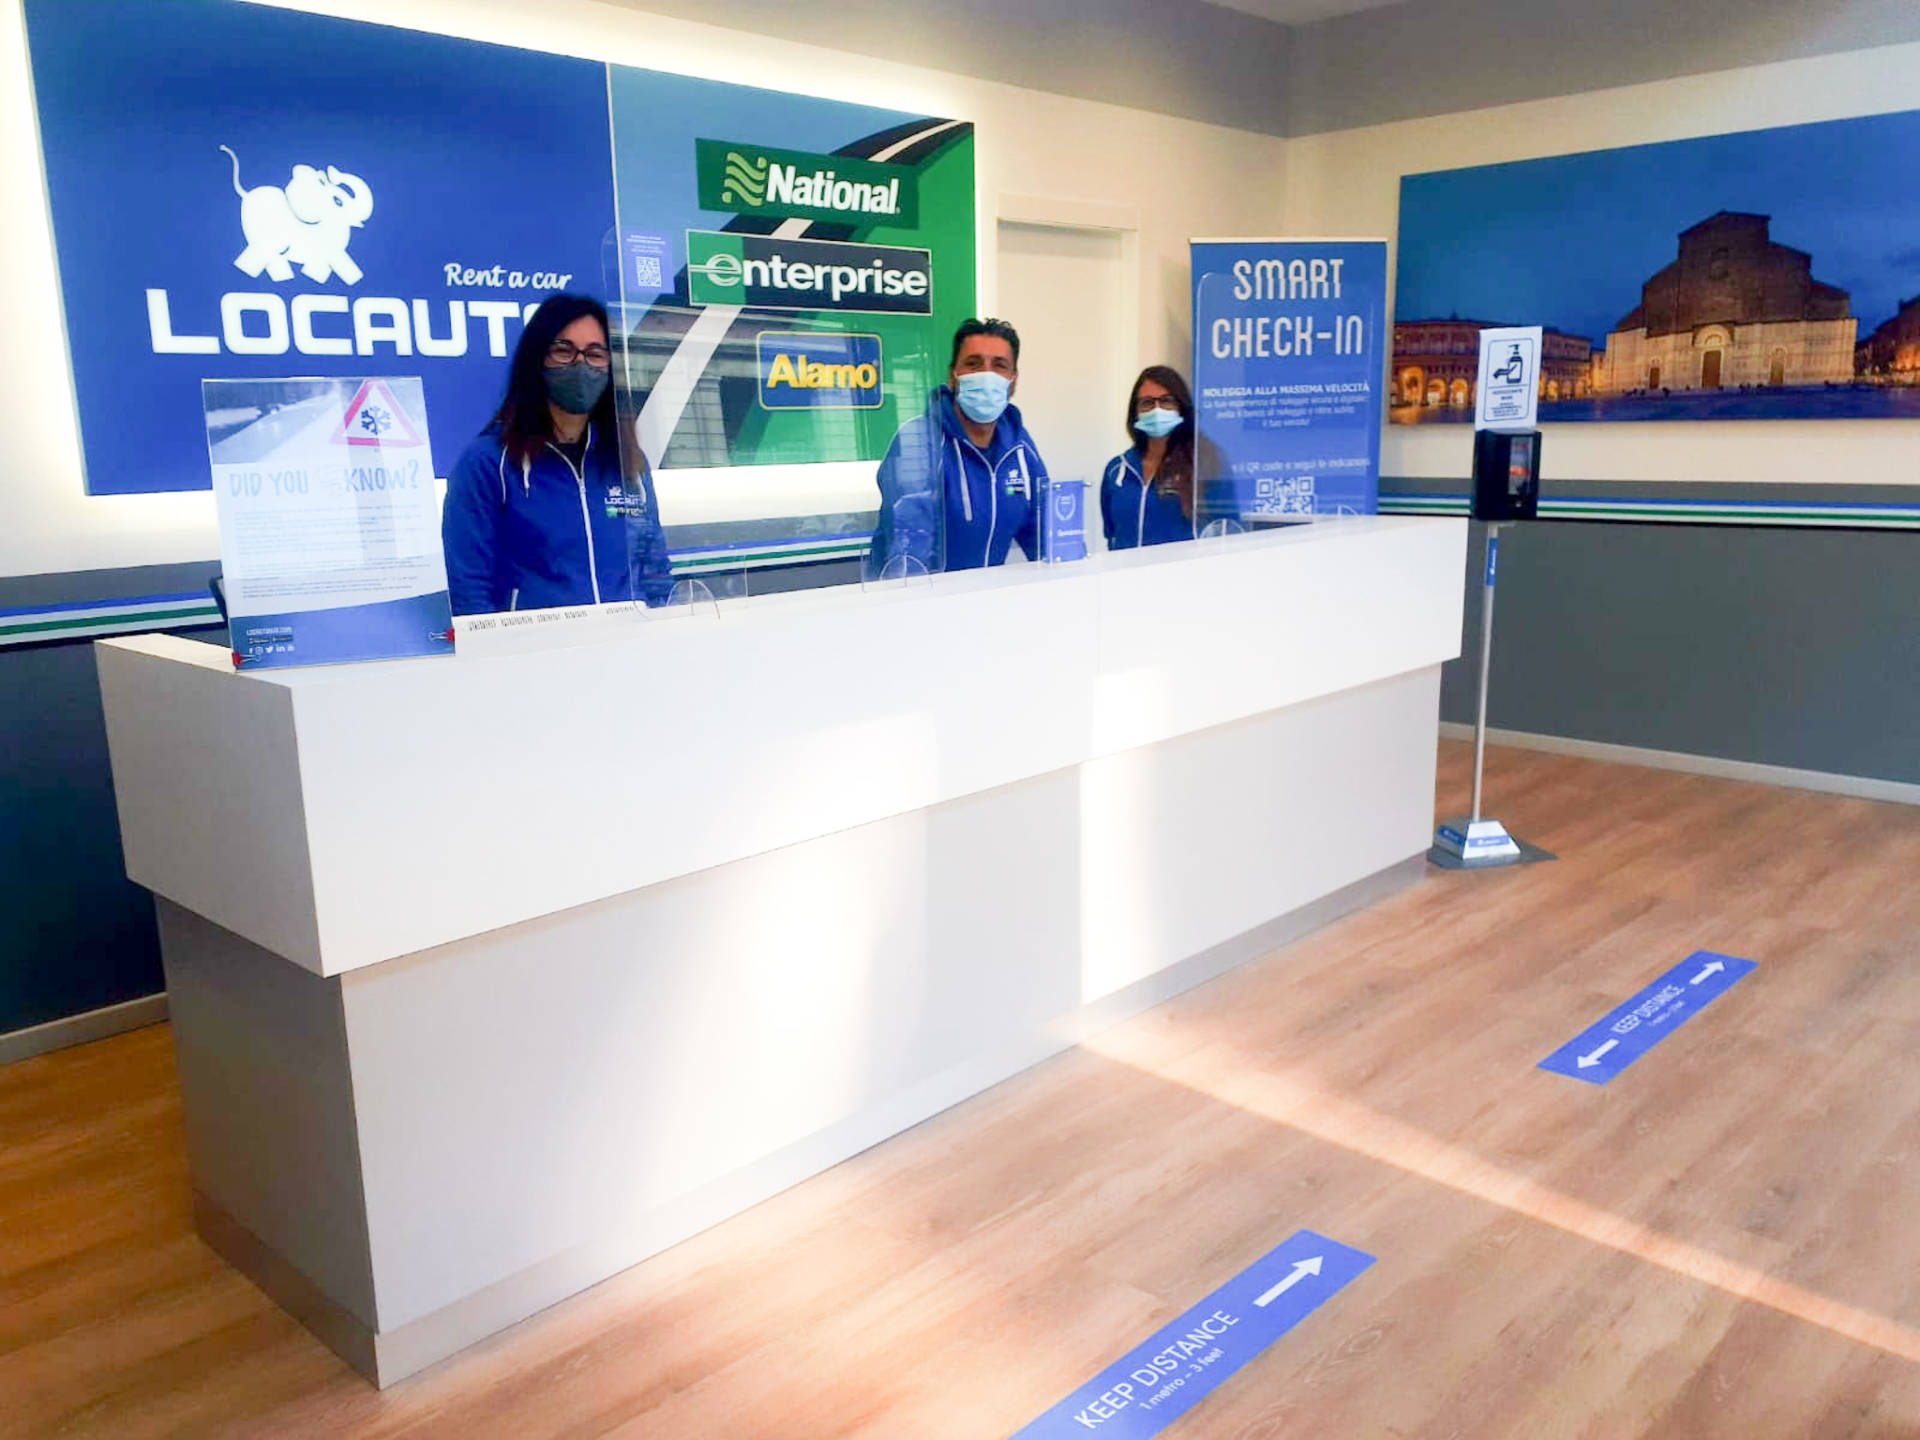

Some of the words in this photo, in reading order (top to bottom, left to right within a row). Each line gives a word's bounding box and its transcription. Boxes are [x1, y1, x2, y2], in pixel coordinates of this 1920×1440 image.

[766, 163, 900, 214] National
[444, 263, 505, 288] Rent
[508, 270, 529, 289] a
[532, 272, 573, 291] car
[705, 254, 928, 301] enterprise
[1233, 258, 1344, 301] SMART
[146, 288, 542, 357] LOCAUT
[1211, 315, 1363, 359] CHECK-IN
[767, 354, 878, 390] Alamo
[1254, 385, 1278, 396] ALLA
[230, 472, 262, 497] DID
[270, 470, 310, 497] YOU
[344, 459, 420, 492] KNOW?
[1073, 1382, 1135, 1429] KEEP
[1130, 1310, 1240, 1388] DISTANCE
[1189, 1363, 1203, 1373] 3
